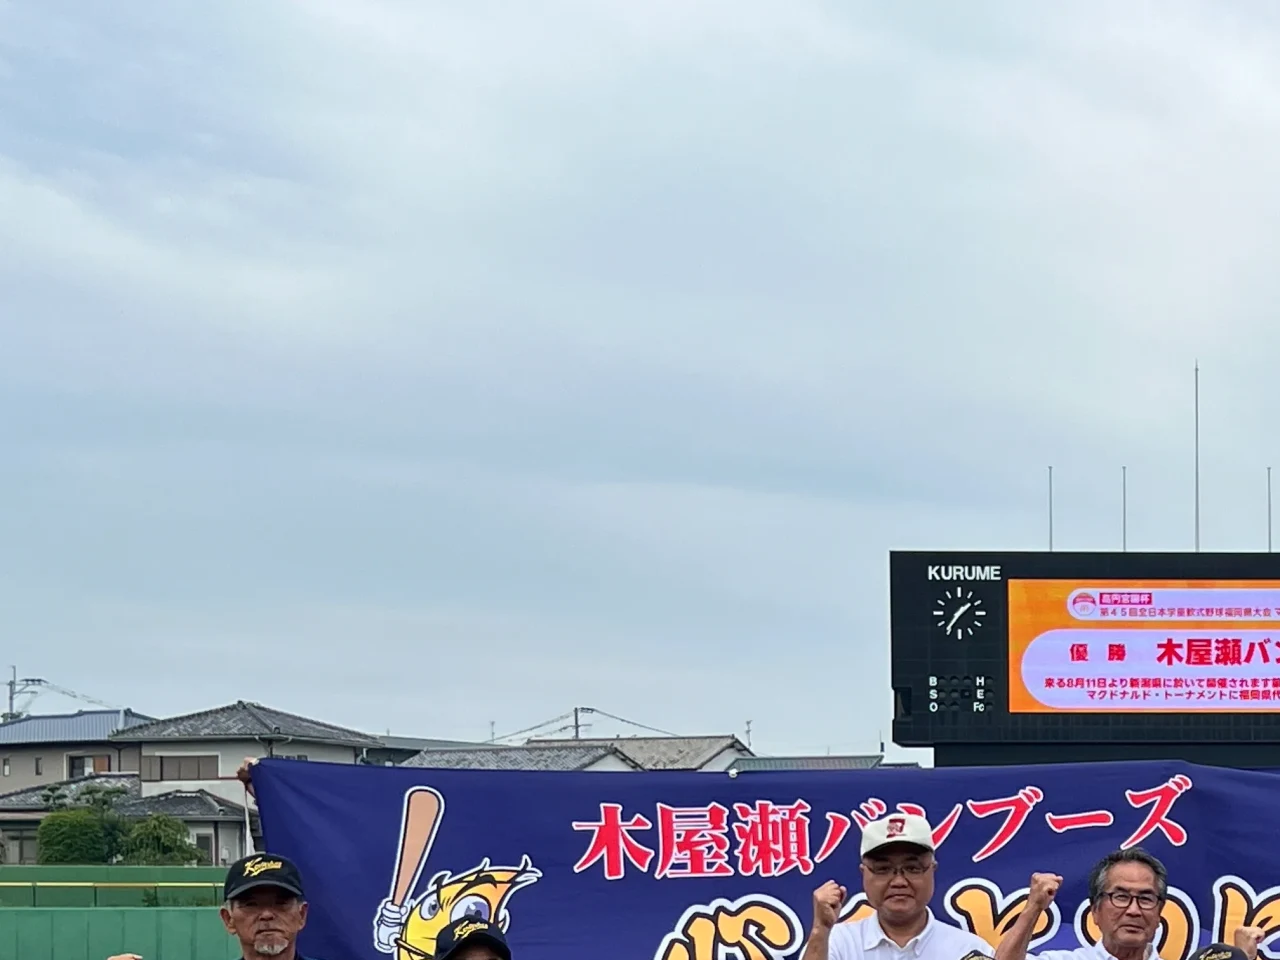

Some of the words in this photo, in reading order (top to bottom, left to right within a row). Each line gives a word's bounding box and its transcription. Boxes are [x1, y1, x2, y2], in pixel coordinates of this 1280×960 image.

[927, 565, 1001, 580] KURUME
[929, 676, 938, 686] B
[975, 676, 985, 687] H
[929, 689, 938, 699] S
[976, 689, 984, 699] E
[572, 773, 1193, 880] 木屋瀬バンブーズ
